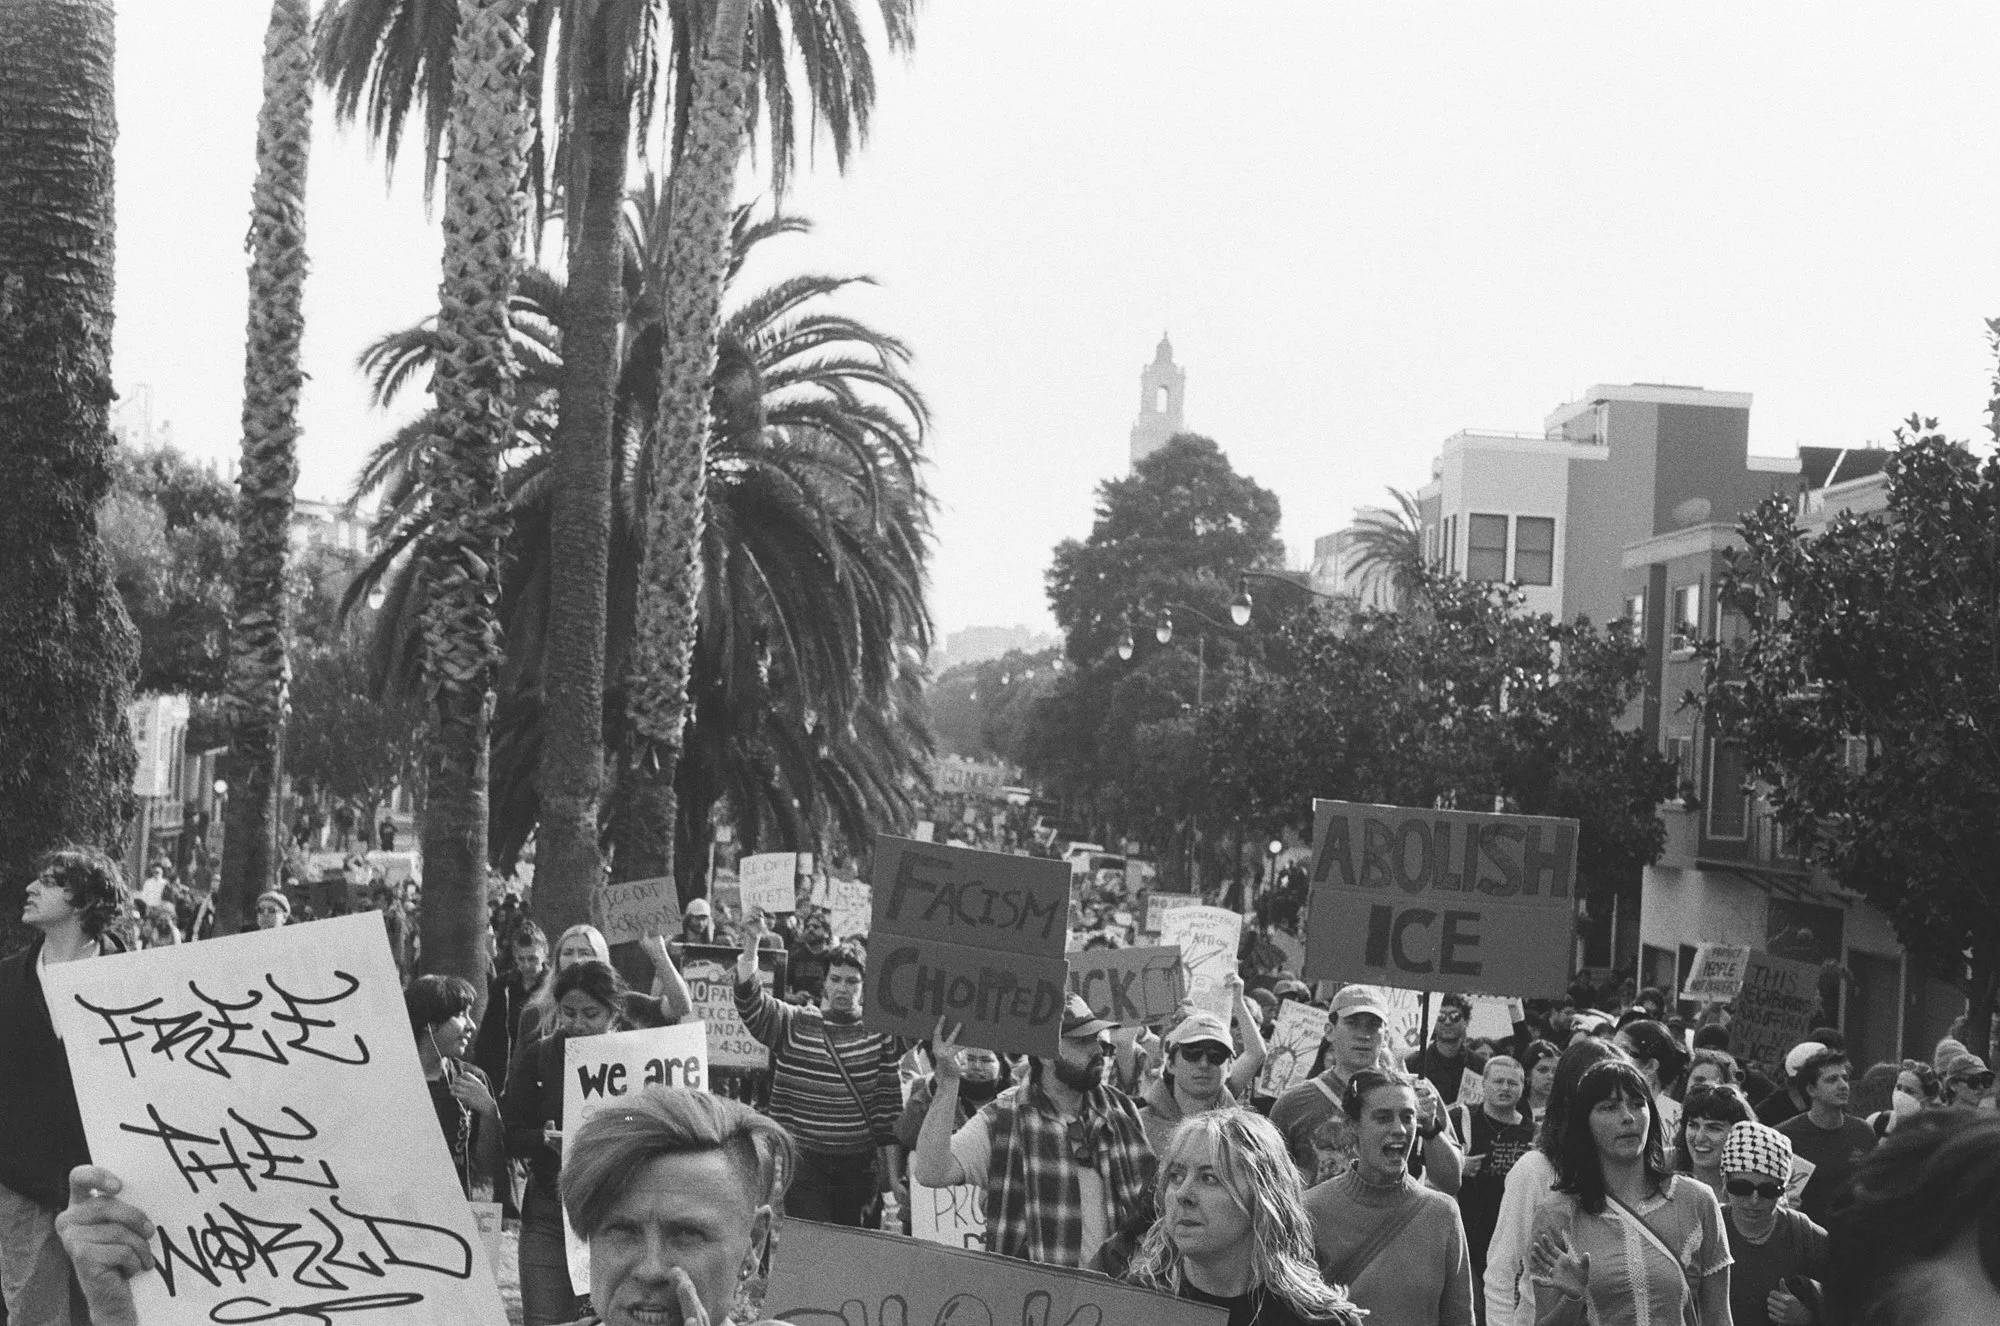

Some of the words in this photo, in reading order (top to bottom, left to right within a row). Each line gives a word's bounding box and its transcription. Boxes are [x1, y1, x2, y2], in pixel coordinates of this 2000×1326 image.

[885, 851, 1062, 940] FACISM
[1314, 815, 1575, 898] ABOLISH
[1365, 904, 1483, 977] ICE
[75, 971, 370, 1079] FREE
[877, 948, 1064, 1026] CHOPPED
[643, 1056, 700, 1090] are
[119, 1103, 340, 1193] THE
[153, 1195, 473, 1297] WORLD
